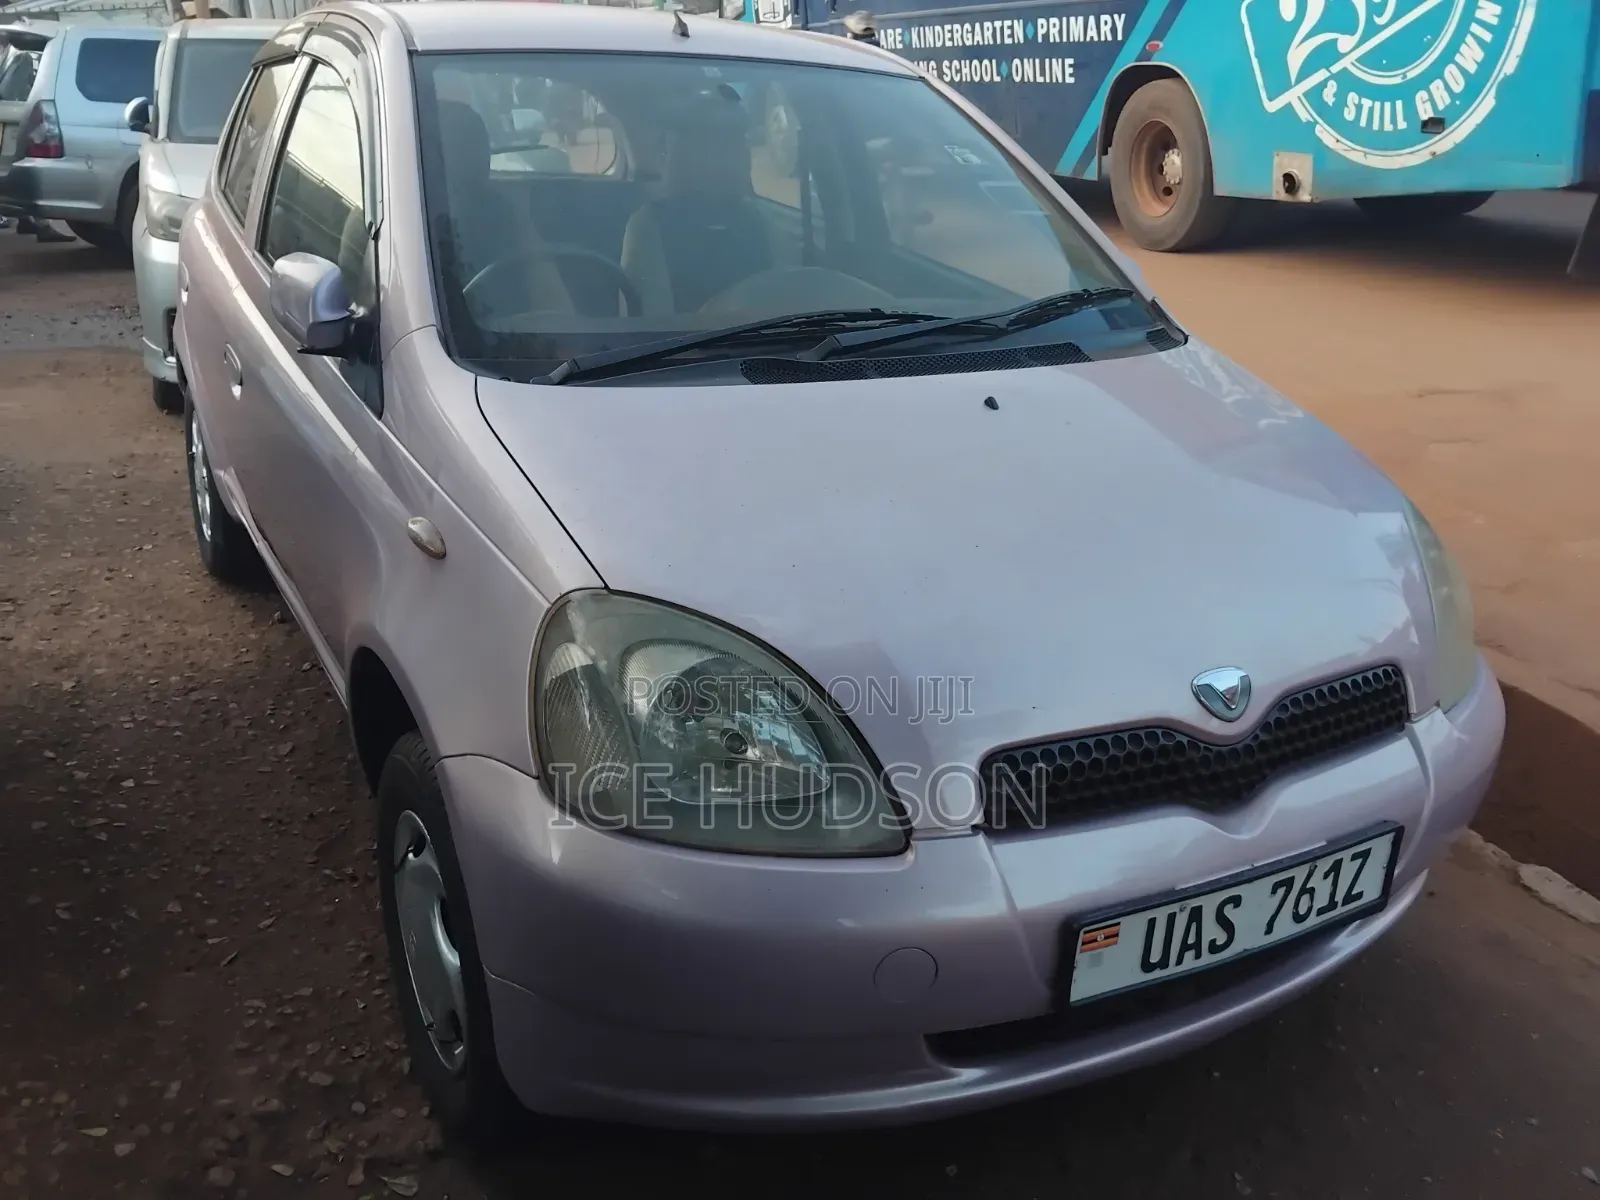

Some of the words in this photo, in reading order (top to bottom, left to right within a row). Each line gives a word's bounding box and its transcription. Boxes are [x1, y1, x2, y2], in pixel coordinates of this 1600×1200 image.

[875, 28, 903, 50] ARE
[911, 19, 1024, 49] KINDERGARTEN
[1037, 13, 1126, 43] PRIMARY
[942, 58, 1001, 83] SCHOOL
[1012, 57, 1075, 83] ONLINE
[1322, 79, 1338, 107] &
[1343, 92, 1407, 131] STILL
[1415, 0, 1502, 121] GROWIN
[1140, 894, 1242, 973] UAS
[1263, 847, 1372, 936] 761Z
